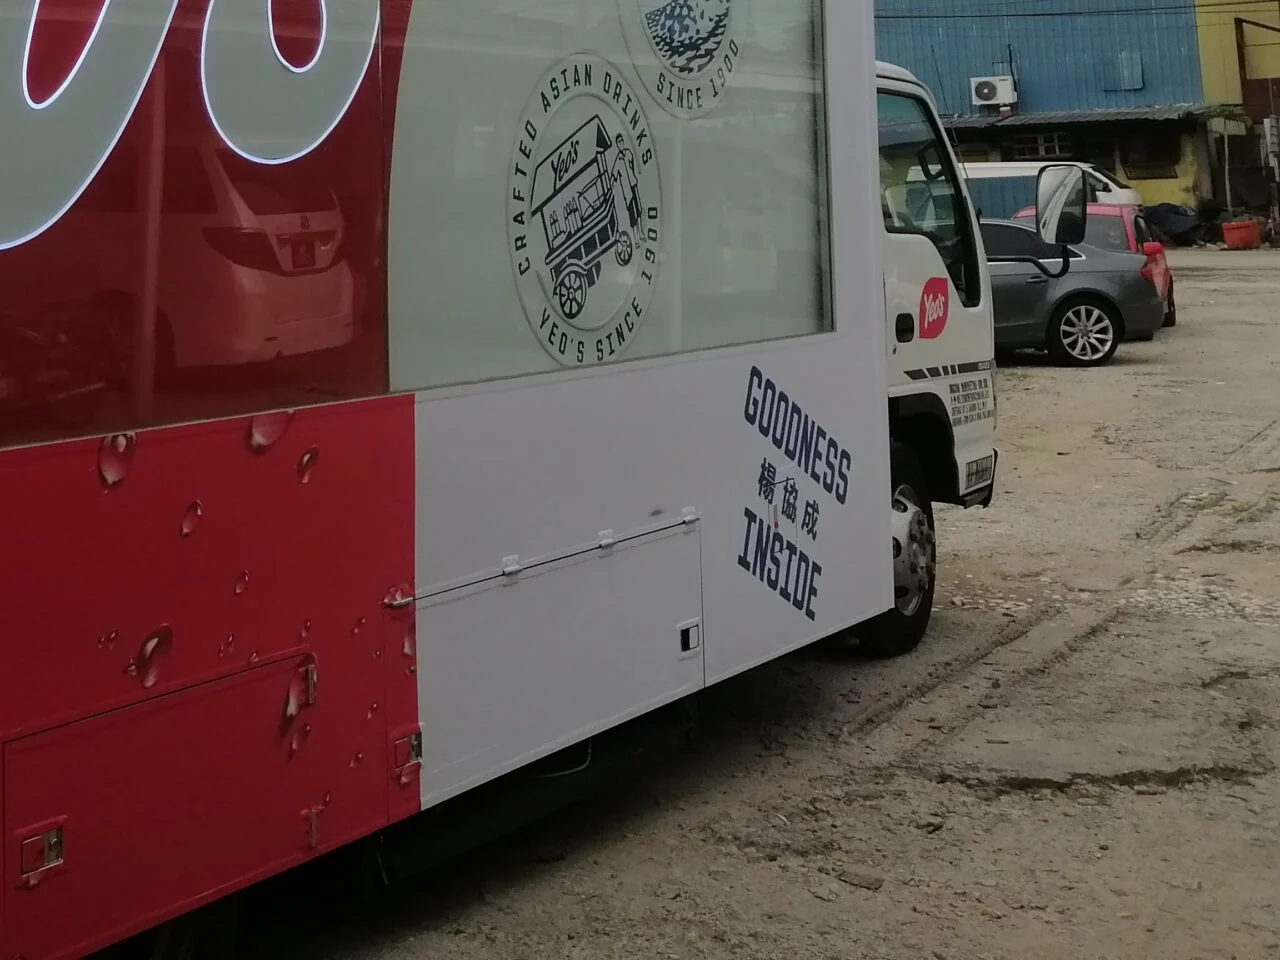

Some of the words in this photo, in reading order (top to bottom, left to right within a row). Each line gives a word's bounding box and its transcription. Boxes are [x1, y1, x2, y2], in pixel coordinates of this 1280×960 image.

[657, 72, 702, 110] SINCE
[712, 38, 739, 99] 1900
[512, 120, 537, 276] CRAFTED
[540, 63, 592, 113] ASIAN
[603, 72, 652, 166] DRINKS
[550, 139, 579, 183] Yeo's
[539, 307, 584, 363] YEO'S
[597, 296, 642, 361] SINCE
[641, 206, 658, 285] 1900
[923, 292, 945, 330] Yeo's
[744, 365, 851, 505] GOODNESS
[758, 457, 820, 541] 楊協成
[738, 506, 822, 622] INSIDE
